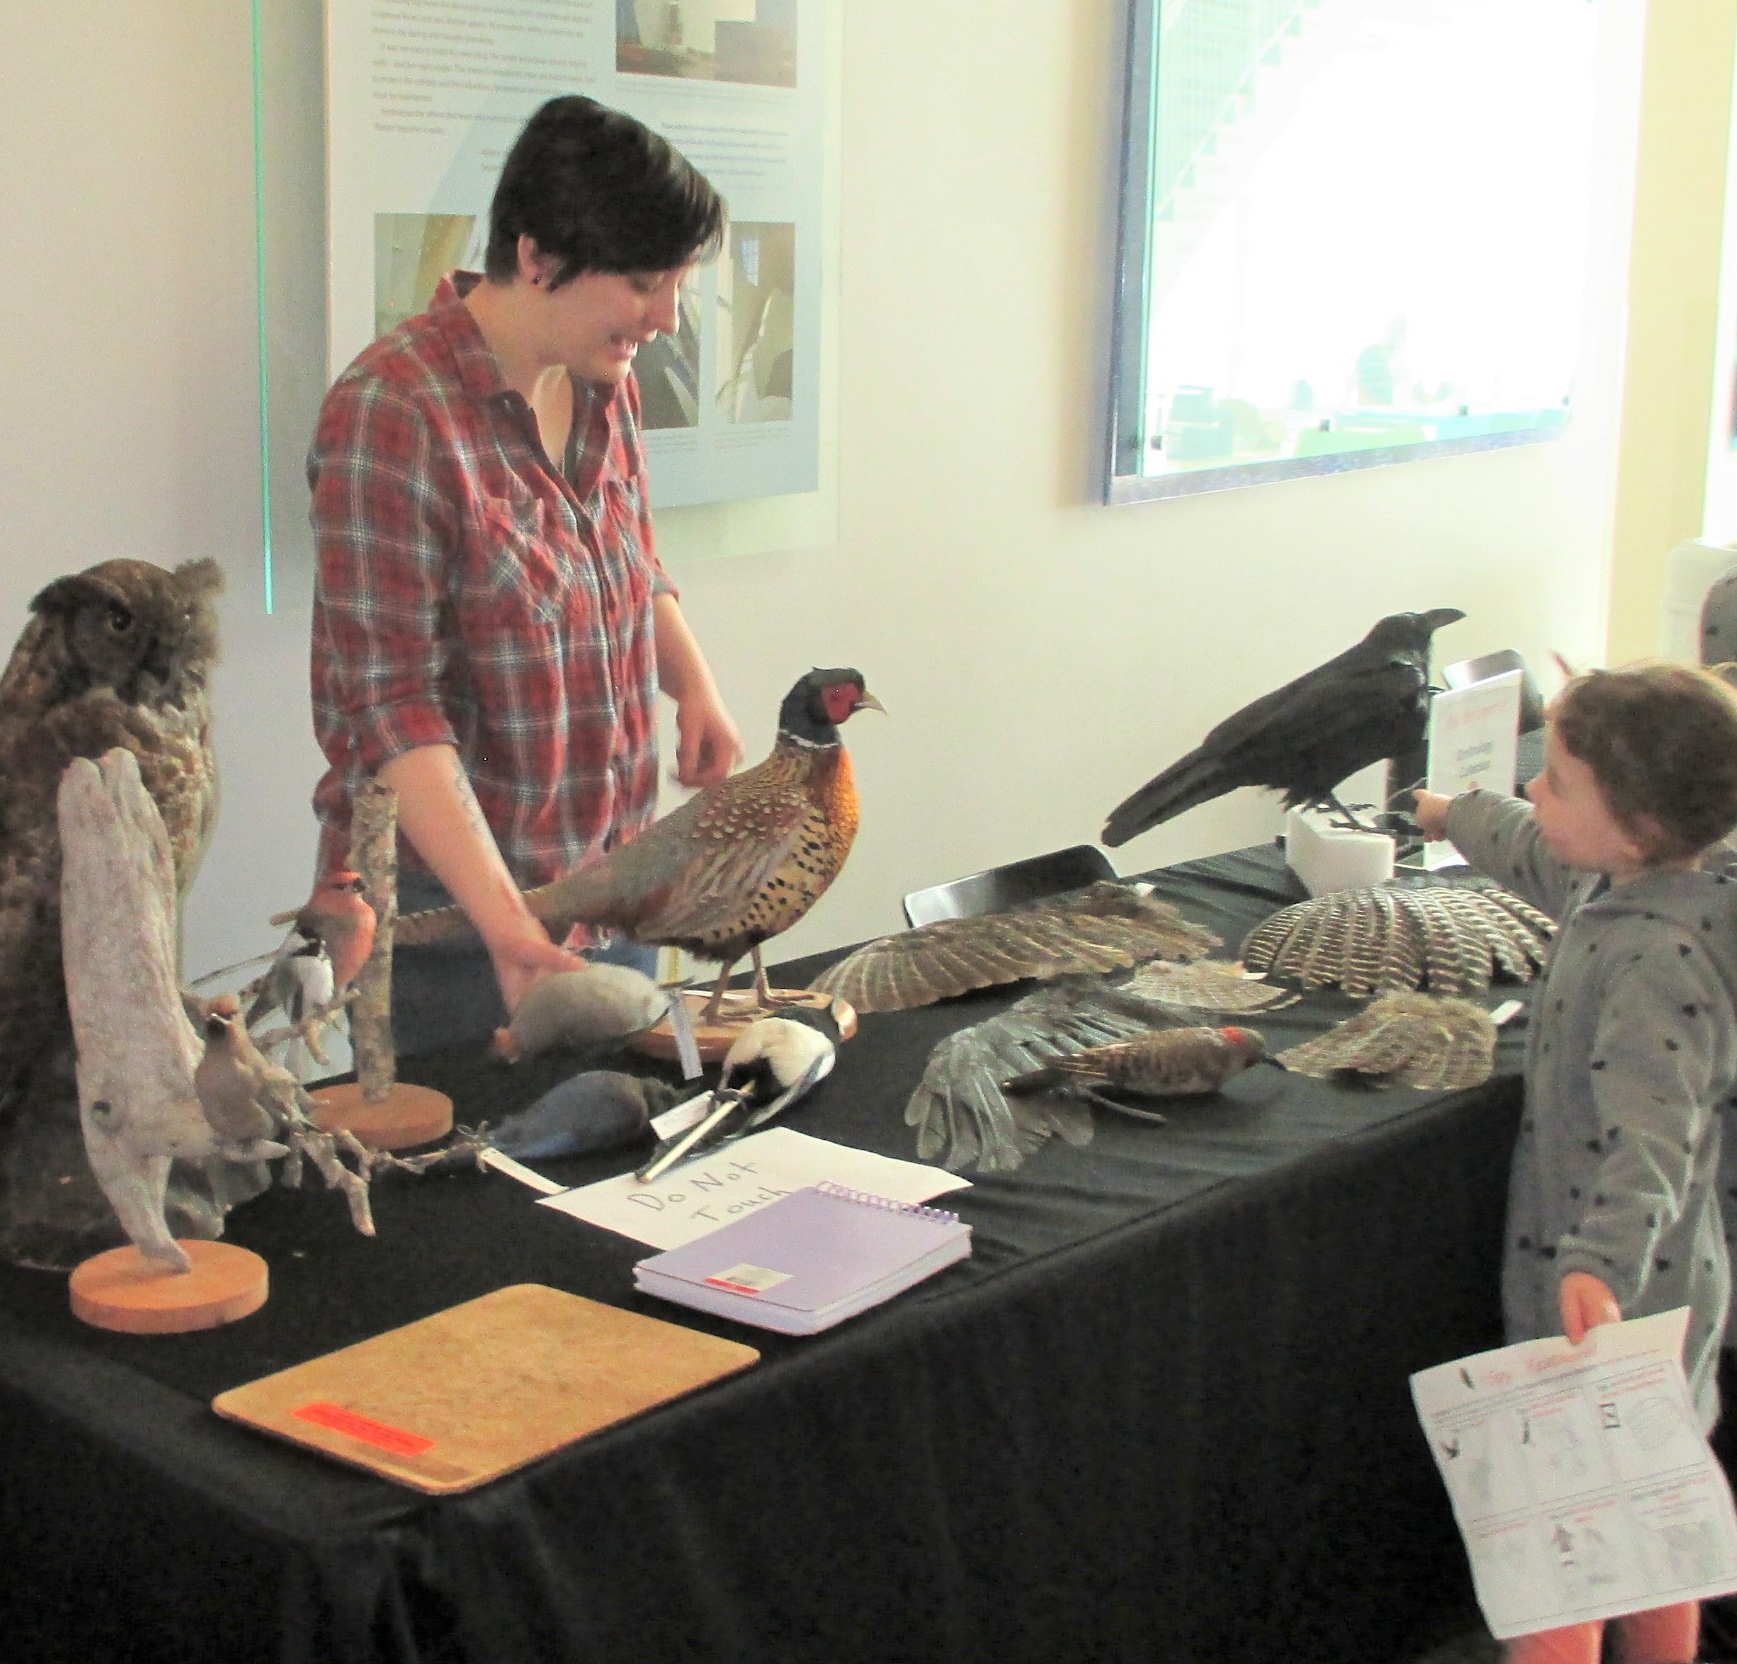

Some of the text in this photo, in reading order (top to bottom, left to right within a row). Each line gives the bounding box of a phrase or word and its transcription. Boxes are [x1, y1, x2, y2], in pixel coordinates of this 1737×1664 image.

[627, 1161, 759, 1212] Do Not
[690, 1186, 793, 1222] Touch
